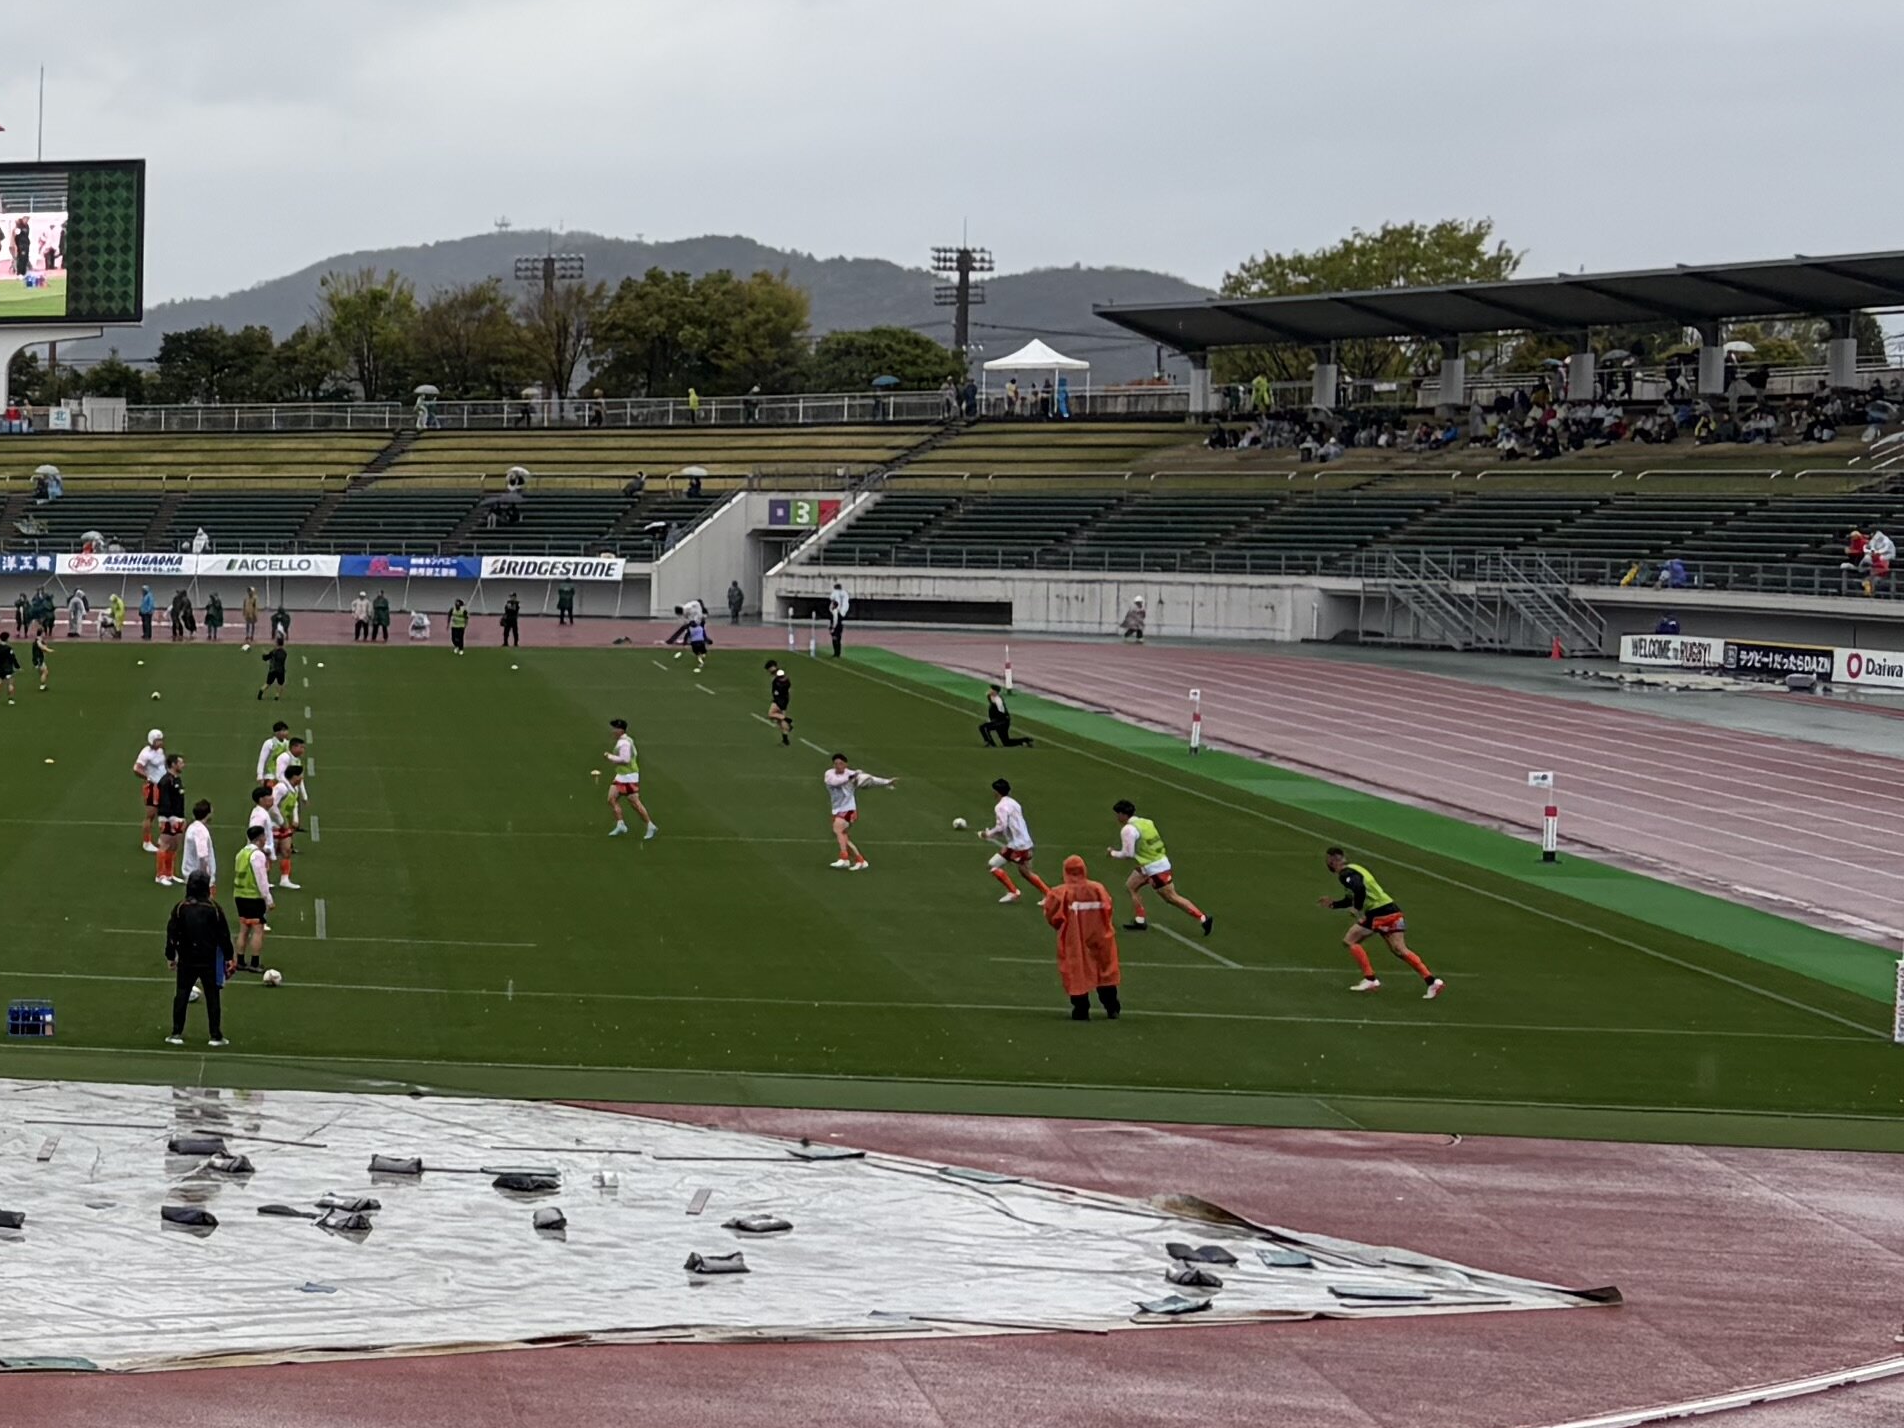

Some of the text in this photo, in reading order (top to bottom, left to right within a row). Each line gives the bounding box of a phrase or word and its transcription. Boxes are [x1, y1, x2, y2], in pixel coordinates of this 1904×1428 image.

[796, 501, 810, 524] 3
[103, 555, 183, 566] ASAHIGAOKA
[239, 558, 312, 571] AICELLO
[489, 558, 616, 578] BRIDGESTONE
[1631, 638, 1672, 660] WELCOME
[1866, 658, 1903, 678] Daiwa
